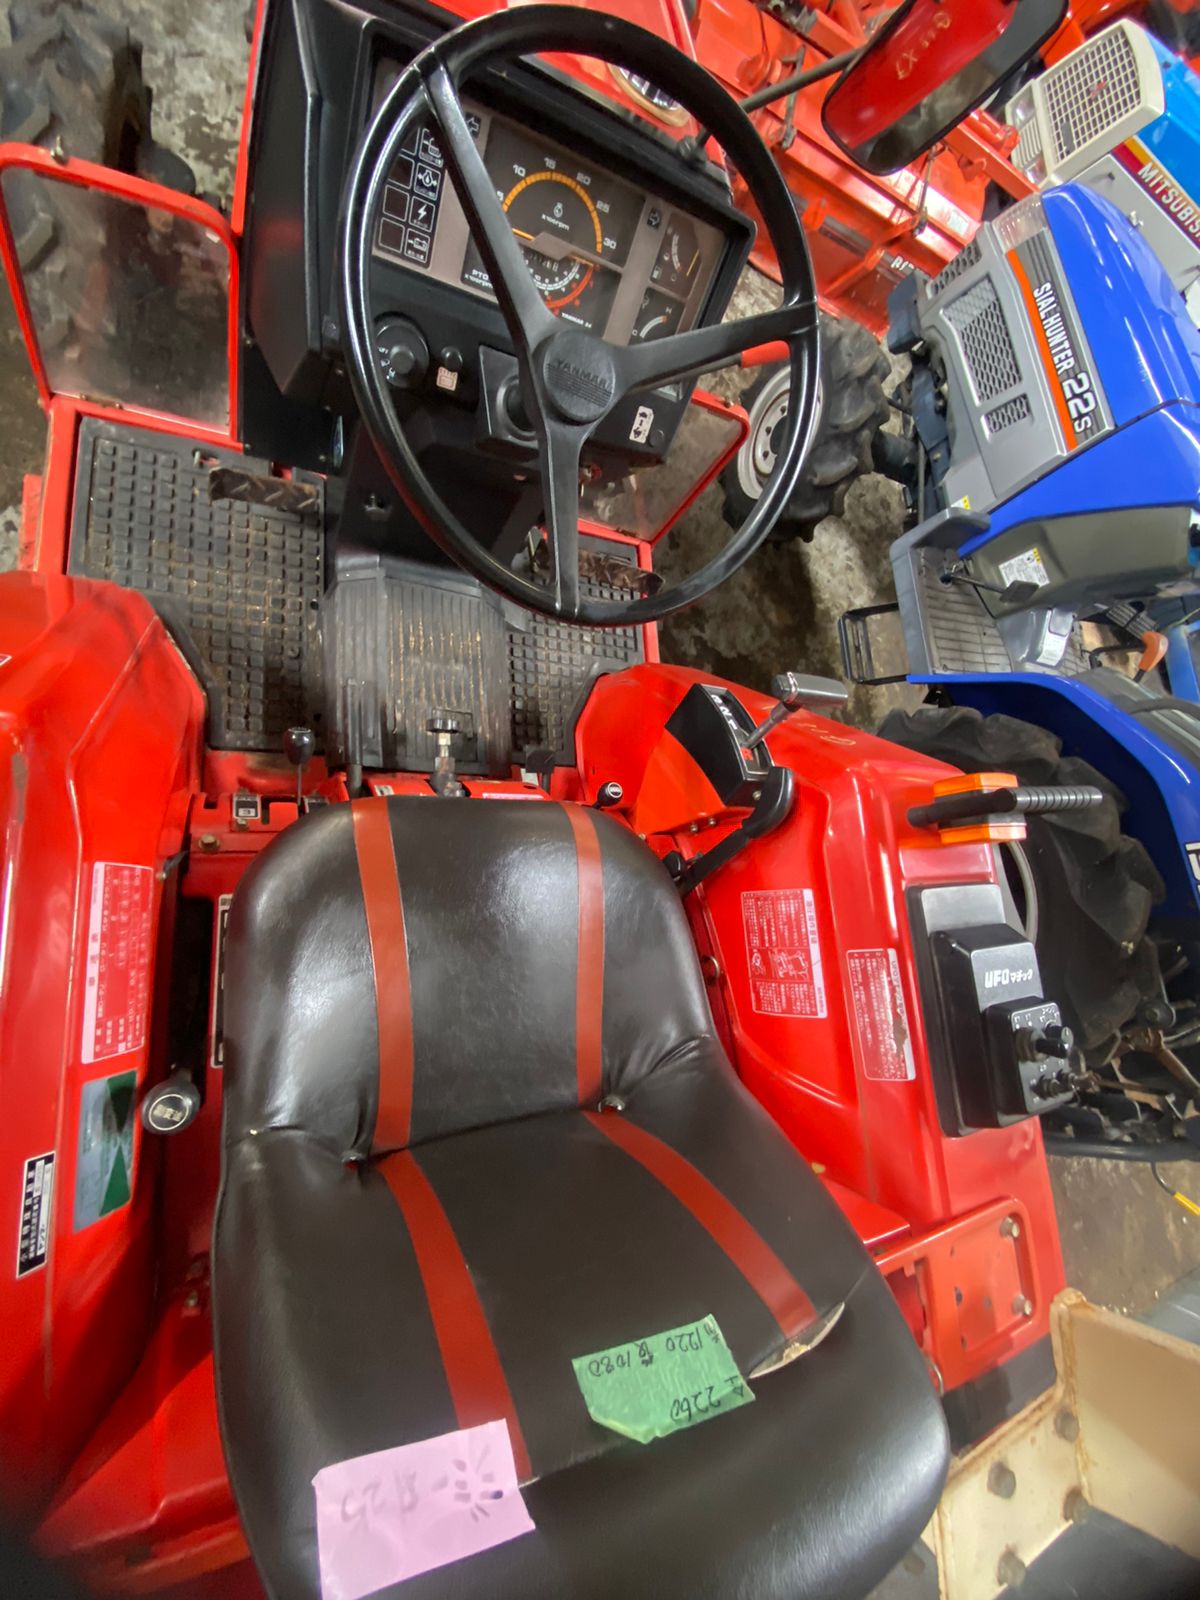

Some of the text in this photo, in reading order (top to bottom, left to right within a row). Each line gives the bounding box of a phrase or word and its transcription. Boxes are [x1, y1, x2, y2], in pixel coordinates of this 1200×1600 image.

[544, 157, 556, 170] 15
[512, 164, 526, 177] 10
[576, 172, 591, 186] 20
[596, 200, 610, 213] 25
[603, 237, 617, 250] 30
[472, 269, 489, 281] PTO
[557, 358, 610, 390] YANMAR
[984, 968, 1034, 989] UFOマチック
